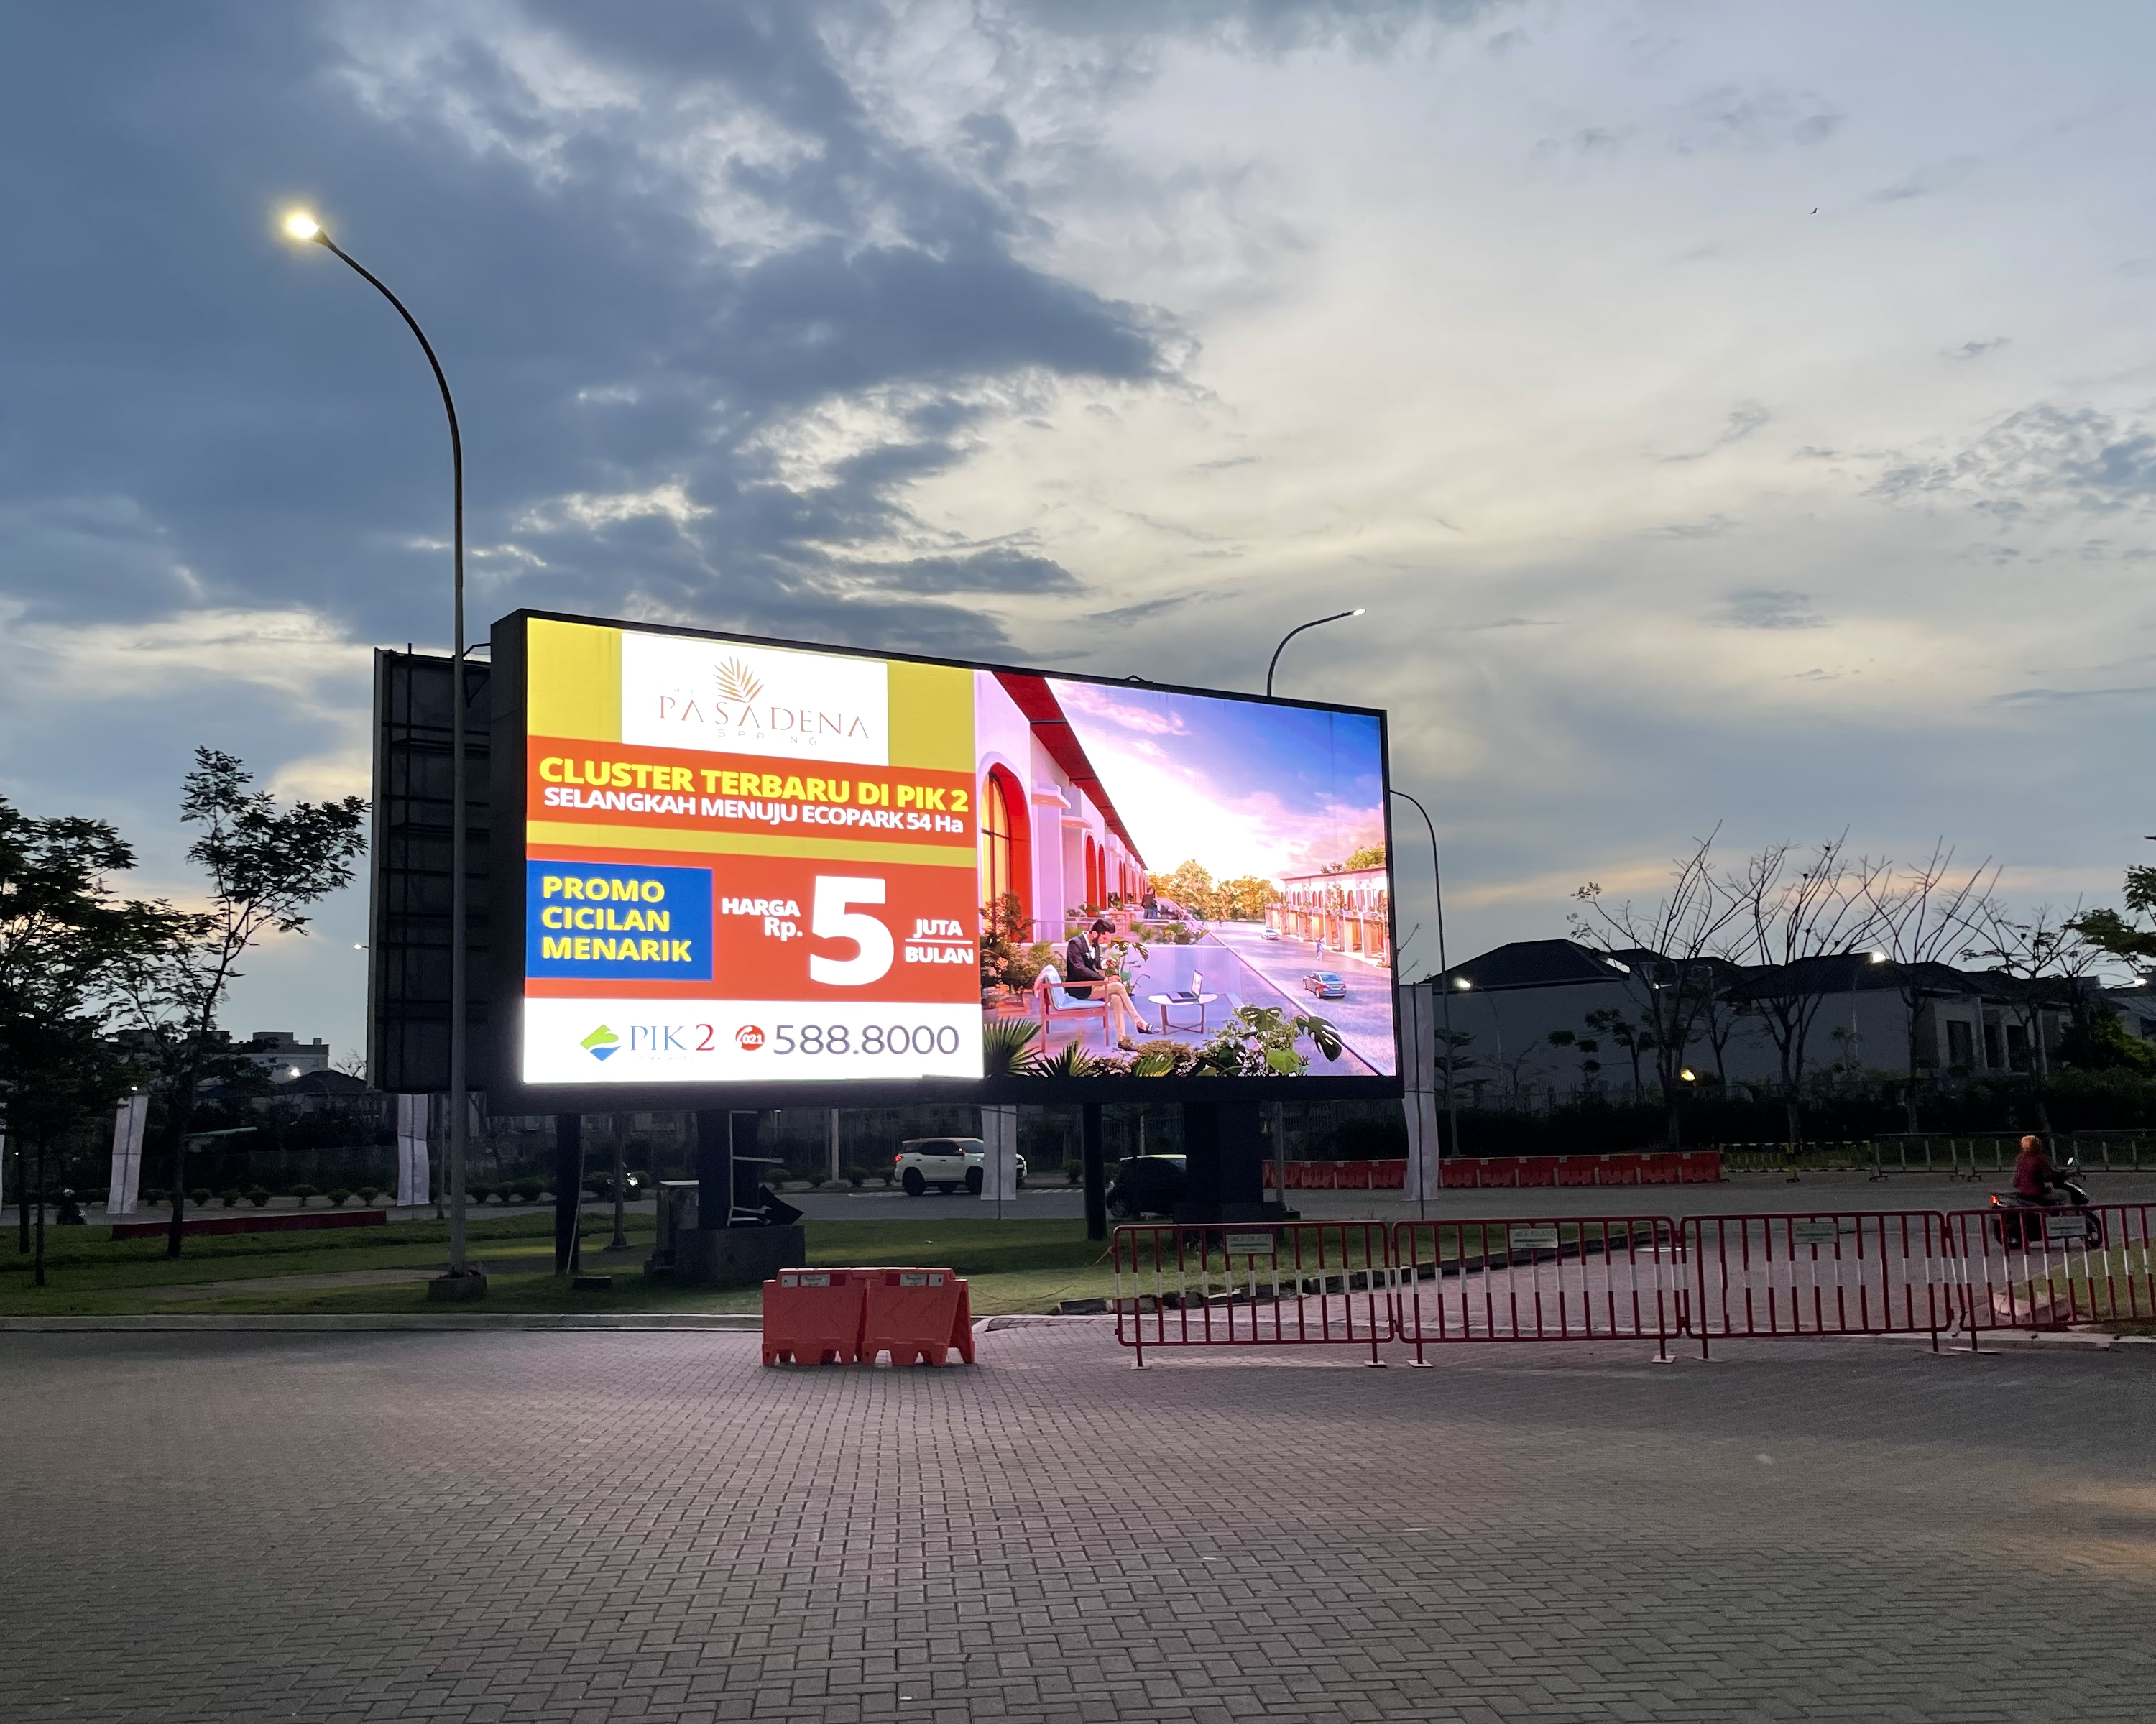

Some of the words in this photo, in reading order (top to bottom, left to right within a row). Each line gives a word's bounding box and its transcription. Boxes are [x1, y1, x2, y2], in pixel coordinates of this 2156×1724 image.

[660, 695, 869, 739] PASADENA
[718, 728, 818, 747] SPRNG
[539, 757, 696, 793] CLUSTER
[700, 768, 850, 803] TERBARU
[858, 781, 889, 806] DI
[897, 785, 946, 811] PIK
[950, 789, 969, 812] 2
[543, 786, 696, 816] SELANGKAH
[701, 798, 798, 826] MENUJU
[802, 804, 905, 830] ECOPARK
[906, 813, 932, 831] 54
[935, 814, 964, 834] Ha
[542, 876, 665, 903] PROMO
[542, 906, 670, 932] CICILAN
[722, 897, 801, 918] HARGA
[764, 917, 803, 942] Rp.
[809, 875, 895, 986] 5
[913, 918, 964, 937] JUTA
[542, 936, 692, 962] MENARIK
[905, 946, 974, 964] BULAN
[630, 1025, 688, 1051] PIK
[695, 1023, 716, 1051] 2
[742, 1034, 763, 1045] 021
[773, 1024, 960, 1055] 588.8000
